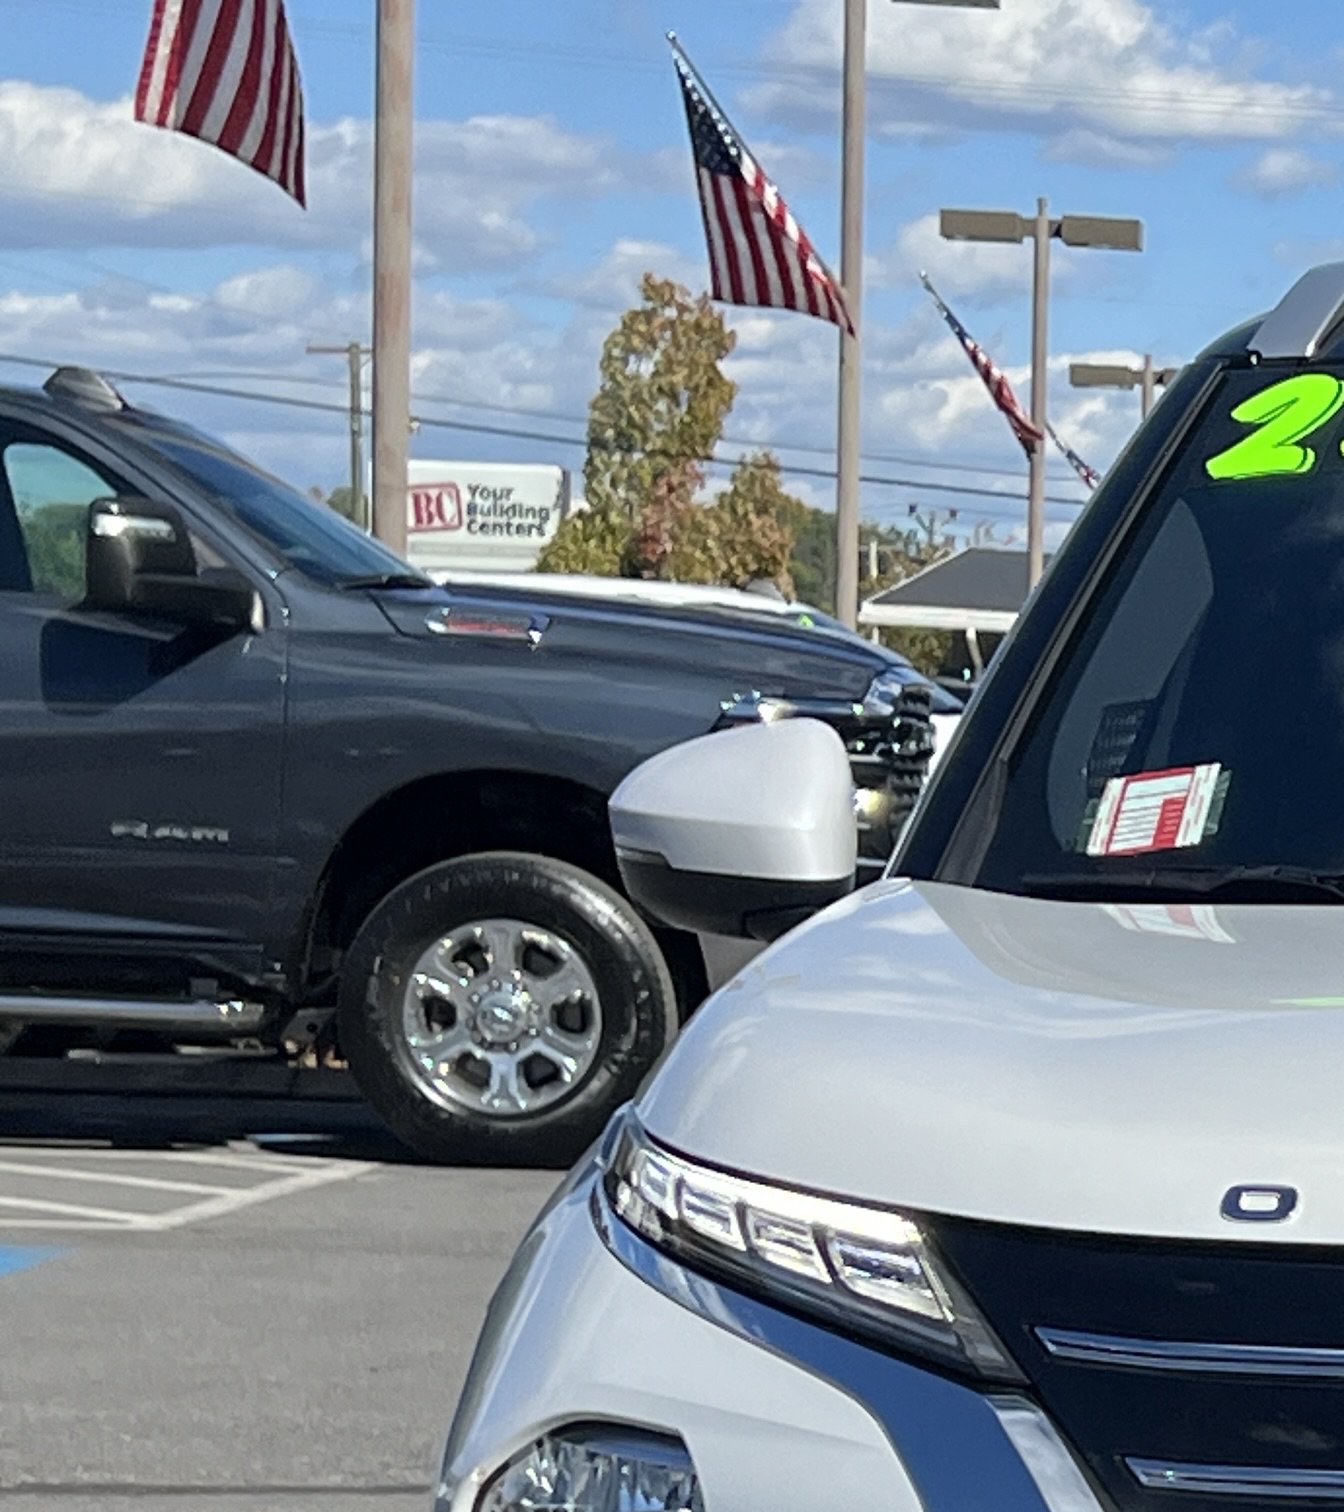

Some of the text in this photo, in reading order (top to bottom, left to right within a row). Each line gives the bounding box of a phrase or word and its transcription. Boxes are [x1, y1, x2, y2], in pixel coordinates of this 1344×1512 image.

[467, 483, 515, 501] Your
[467, 502, 549, 523] Building
[467, 518, 546, 537] Centers
[111, 822, 229, 841] RAM
